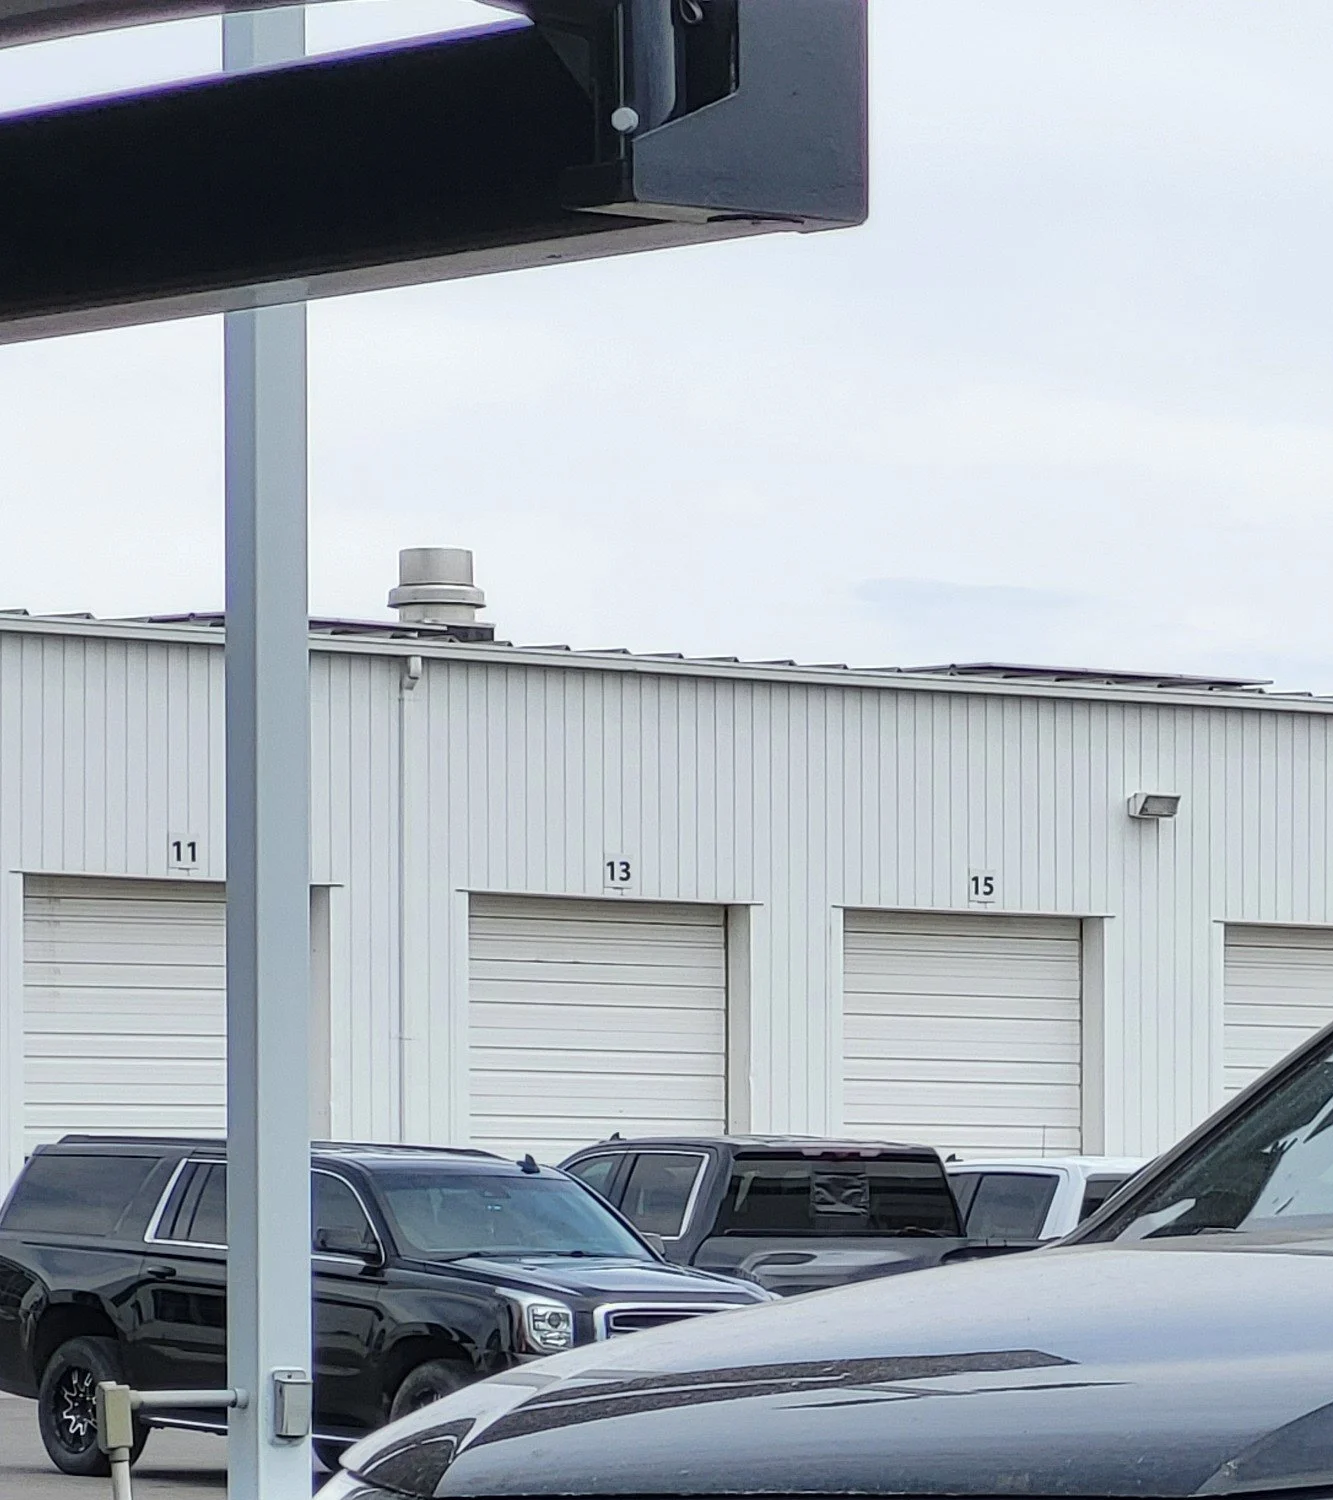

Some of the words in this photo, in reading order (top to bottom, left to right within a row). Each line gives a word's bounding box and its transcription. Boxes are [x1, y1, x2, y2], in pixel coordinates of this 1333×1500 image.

[172, 841, 196, 862] 11
[606, 861, 631, 881] 13
[971, 876, 994, 896] 15
